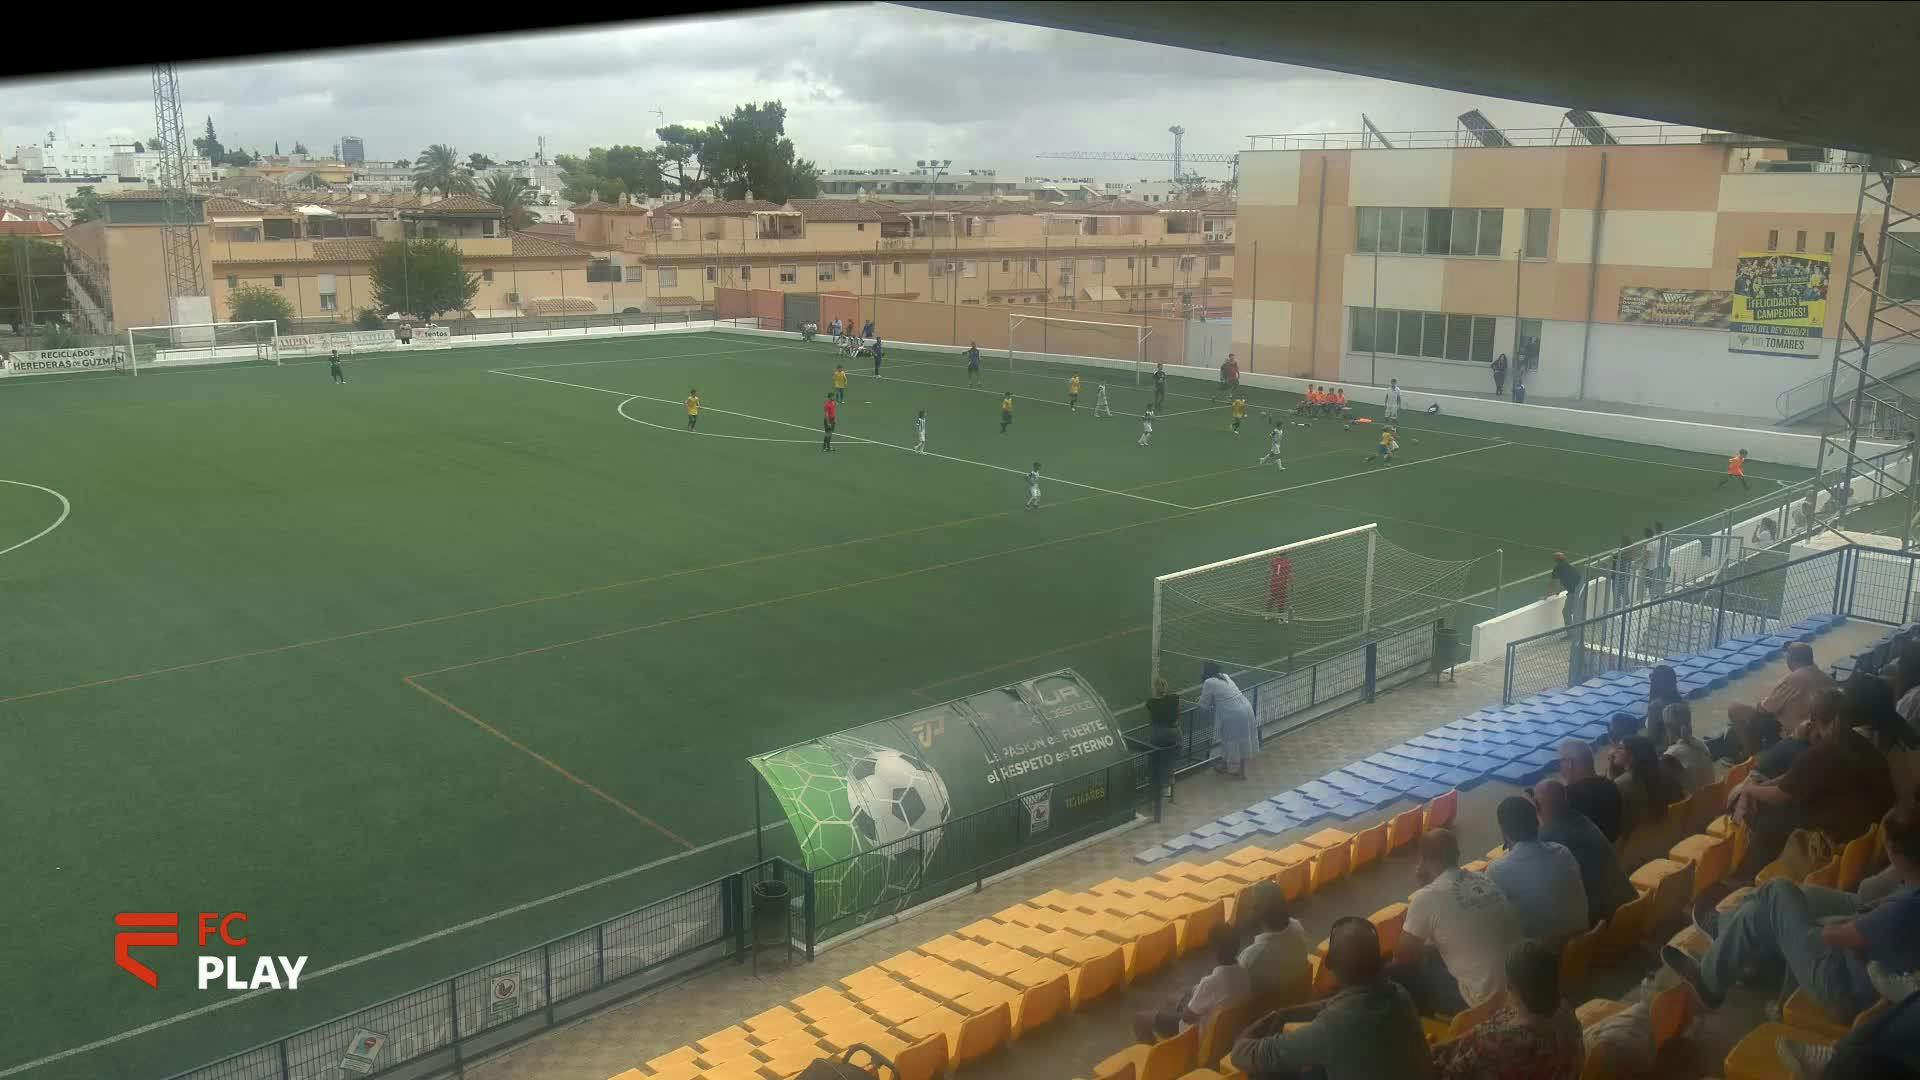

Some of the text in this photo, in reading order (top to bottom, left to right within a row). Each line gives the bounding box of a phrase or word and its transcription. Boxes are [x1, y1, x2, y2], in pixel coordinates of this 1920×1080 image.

[1757, 307, 1806, 319] CAMPEONES!
[1741, 324, 1758, 332] COPA
[1770, 327, 1782, 335] REY
[1765, 337, 1805, 350] TOMARES
[41, 349, 95, 360] RECICLADOS
[13, 360, 72, 371] HEREDERAS
[1071, 735, 1114, 758] ETERNO
